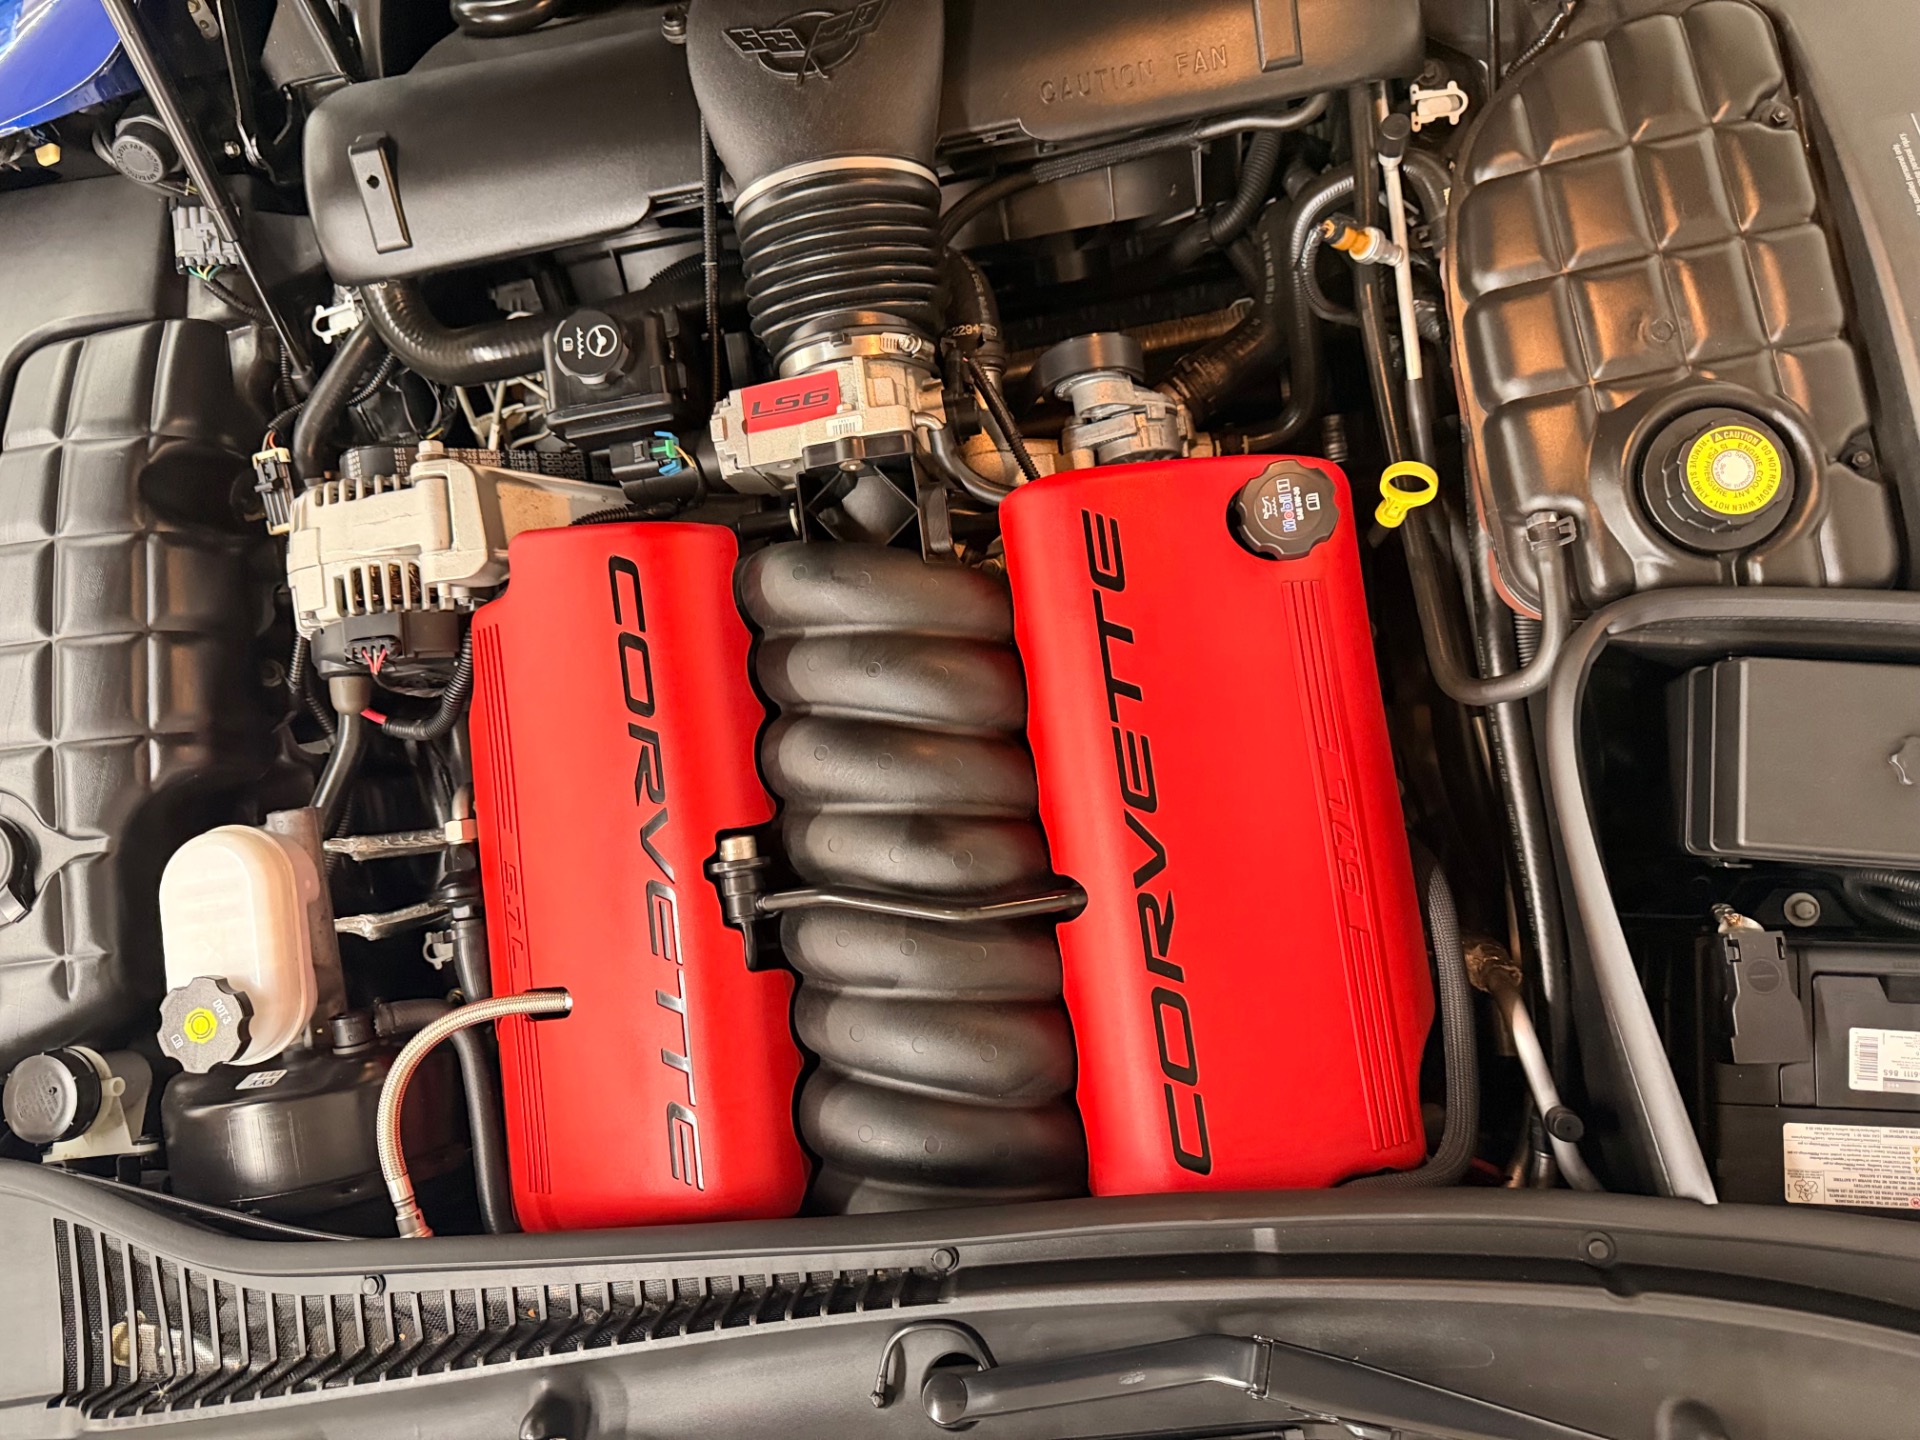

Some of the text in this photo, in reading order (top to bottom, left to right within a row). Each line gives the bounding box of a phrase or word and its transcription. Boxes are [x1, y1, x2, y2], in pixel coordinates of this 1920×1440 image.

[1040, 44, 1229, 104] CAUTION FAN
[751, 388, 829, 415] LS6
[1723, 431, 1759, 445] CAUTION
[1690, 440, 1708, 499] REMOVE SLOWLY
[1714, 445, 1776, 511] DO NOT REMOVE WHEN HOT
[1734, 442, 1763, 498] ENGINE COOLANT
[1278, 493, 1297, 532] Mobil
[1292, 486, 1304, 521] SAE 5W-30
[1080, 508, 1213, 1176] CORVETTE
[1328, 777, 1364, 899] 5.7L
[609, 554, 705, 1192] CORVETTE
[502, 859, 525, 970] 5.7L
[212, 998, 232, 1025] DOT 3
